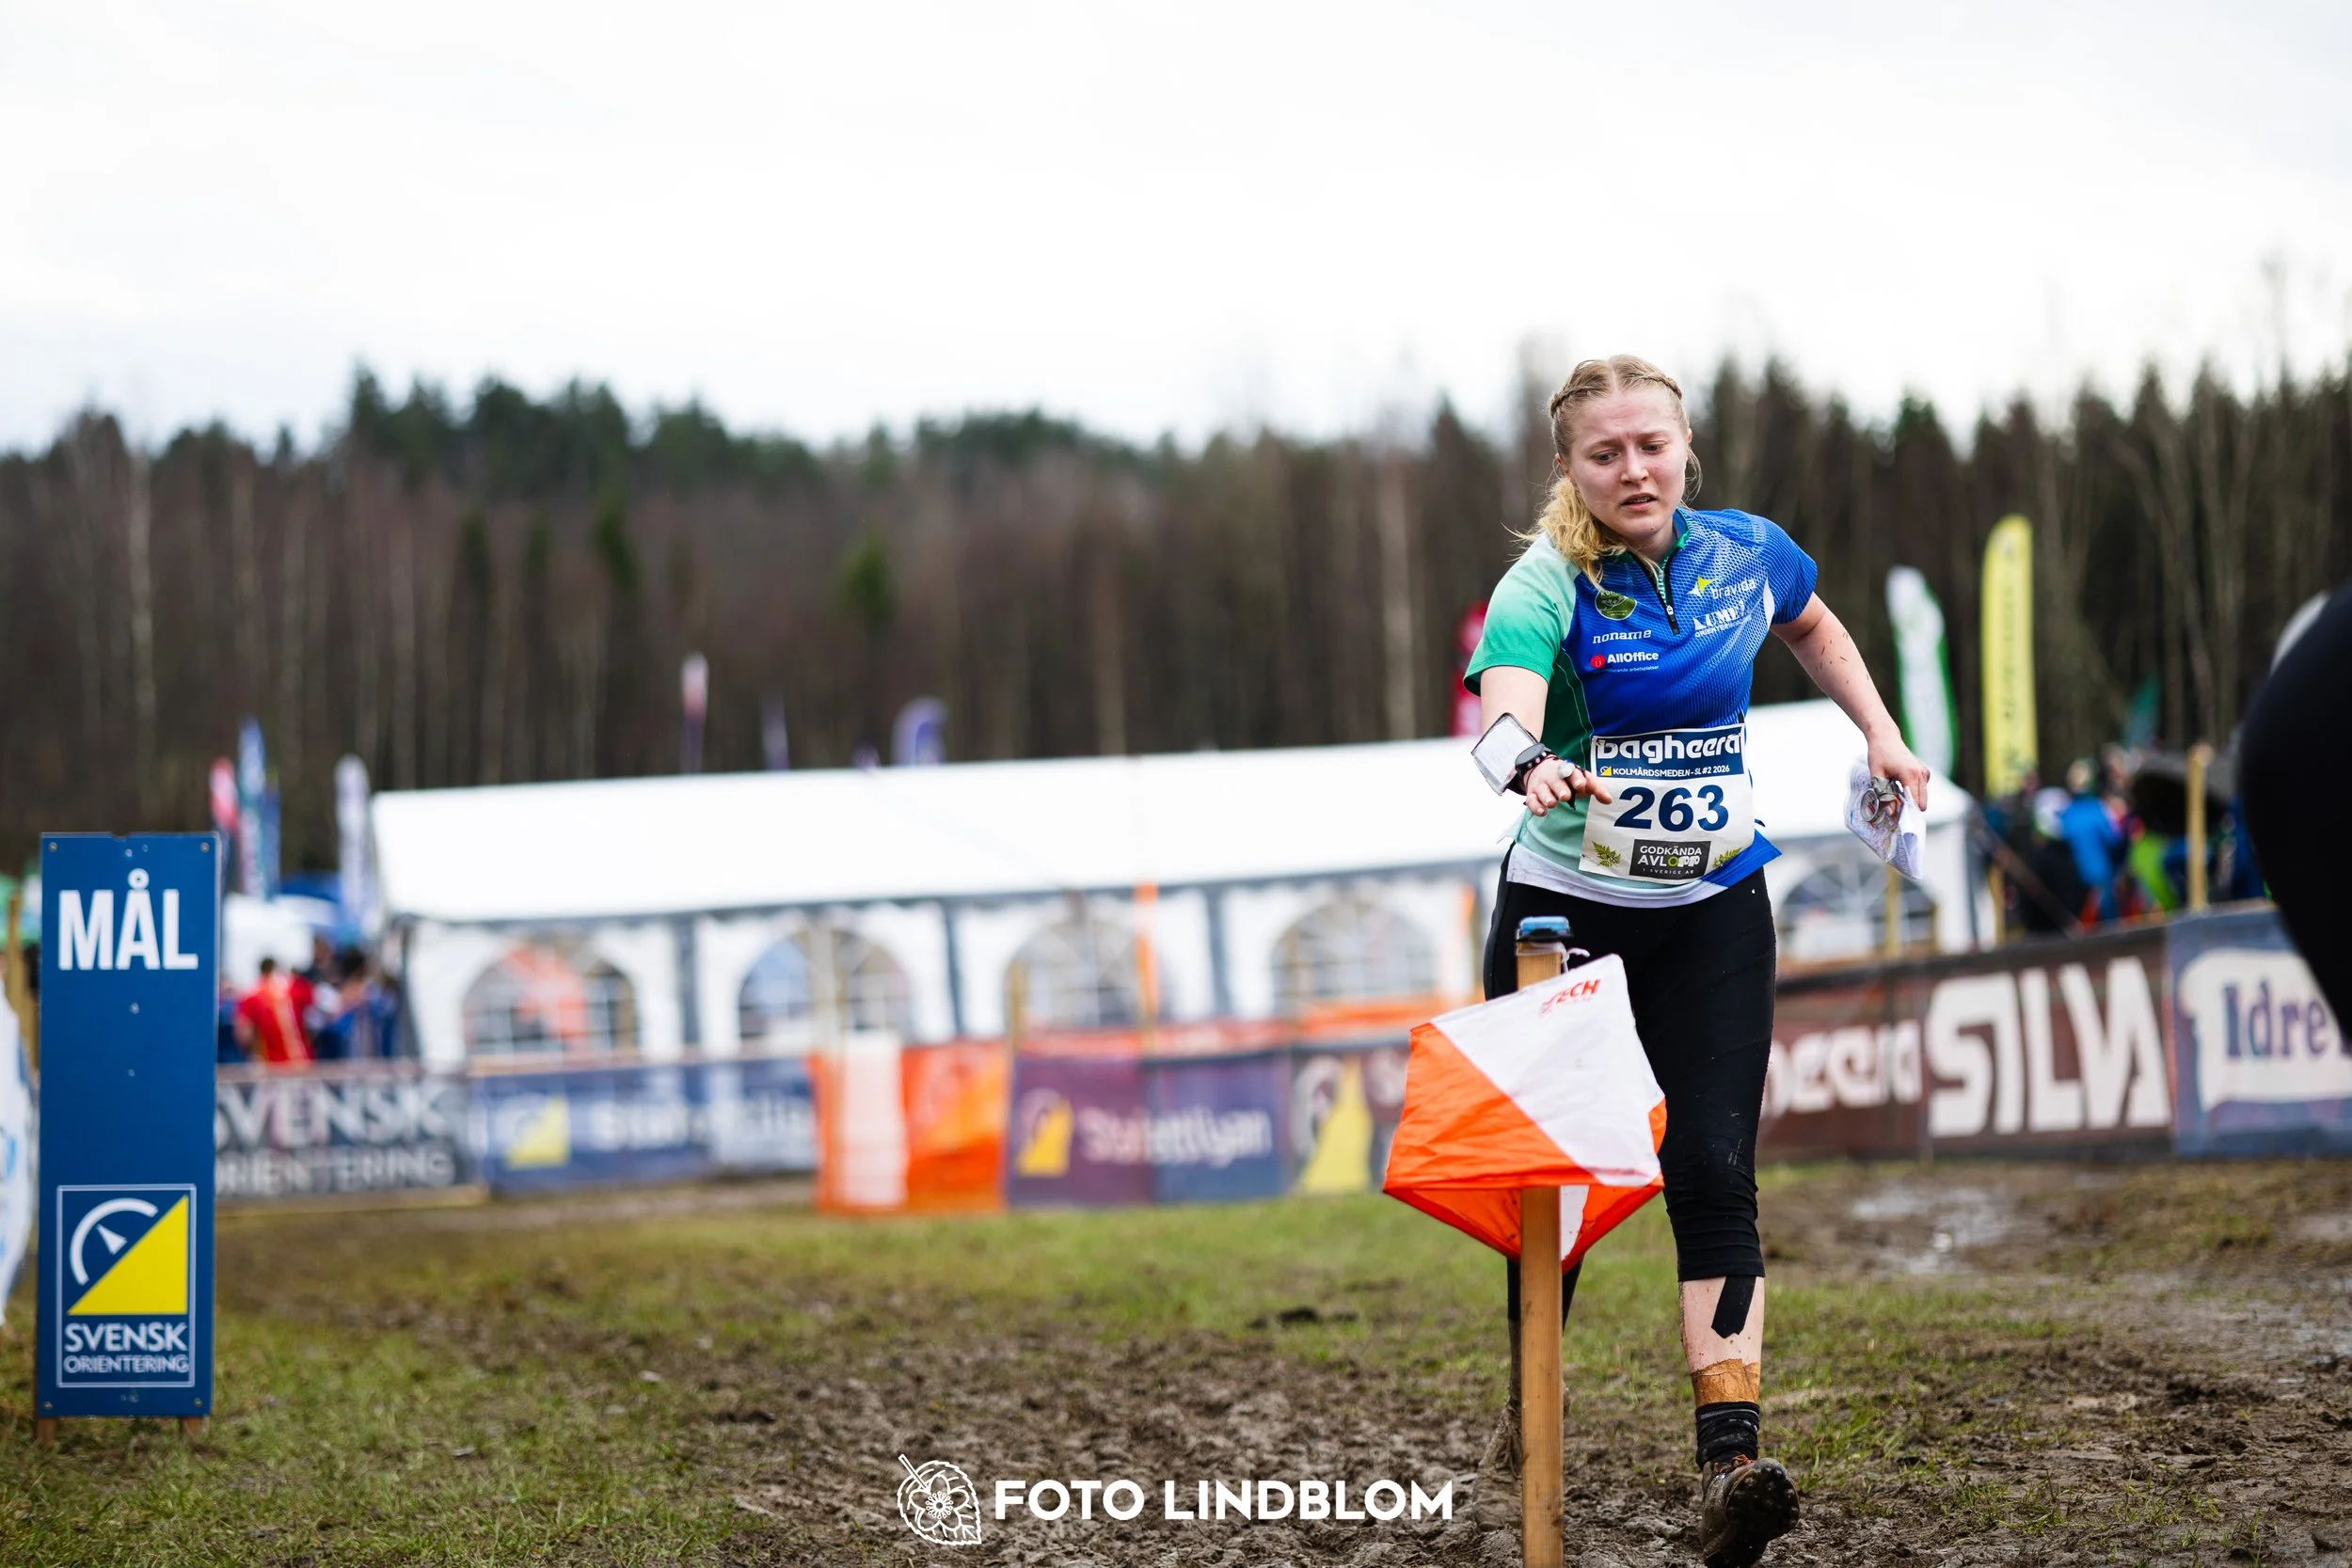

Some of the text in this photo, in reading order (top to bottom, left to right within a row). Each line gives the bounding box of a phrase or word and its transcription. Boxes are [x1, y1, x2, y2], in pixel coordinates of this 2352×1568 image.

[1710, 577, 1756, 600] bravida
[1593, 629, 1652, 644] noname
[1607, 651, 1660, 664] AllOffice
[1597, 733, 1742, 765] bagheera
[1613, 766, 1690, 778] KOLMÅRDSMEDELN
[1702, 766, 1712, 775] #2
[1712, 764, 1730, 774] 2026
[1613, 784, 1729, 832] 263
[1637, 854, 1700, 868] AVLOPP
[1640, 845, 1702, 856] GODKÄNDA
[1649, 867, 1682, 876] SVERIGE
[58, 868, 199, 971] MÅL
[2222, 978, 2328, 1057] Idre
[1925, 956, 2172, 1139] SILVA
[64, 1322, 188, 1353] SVENSK
[63, 1354, 189, 1374] ORIENTERING
